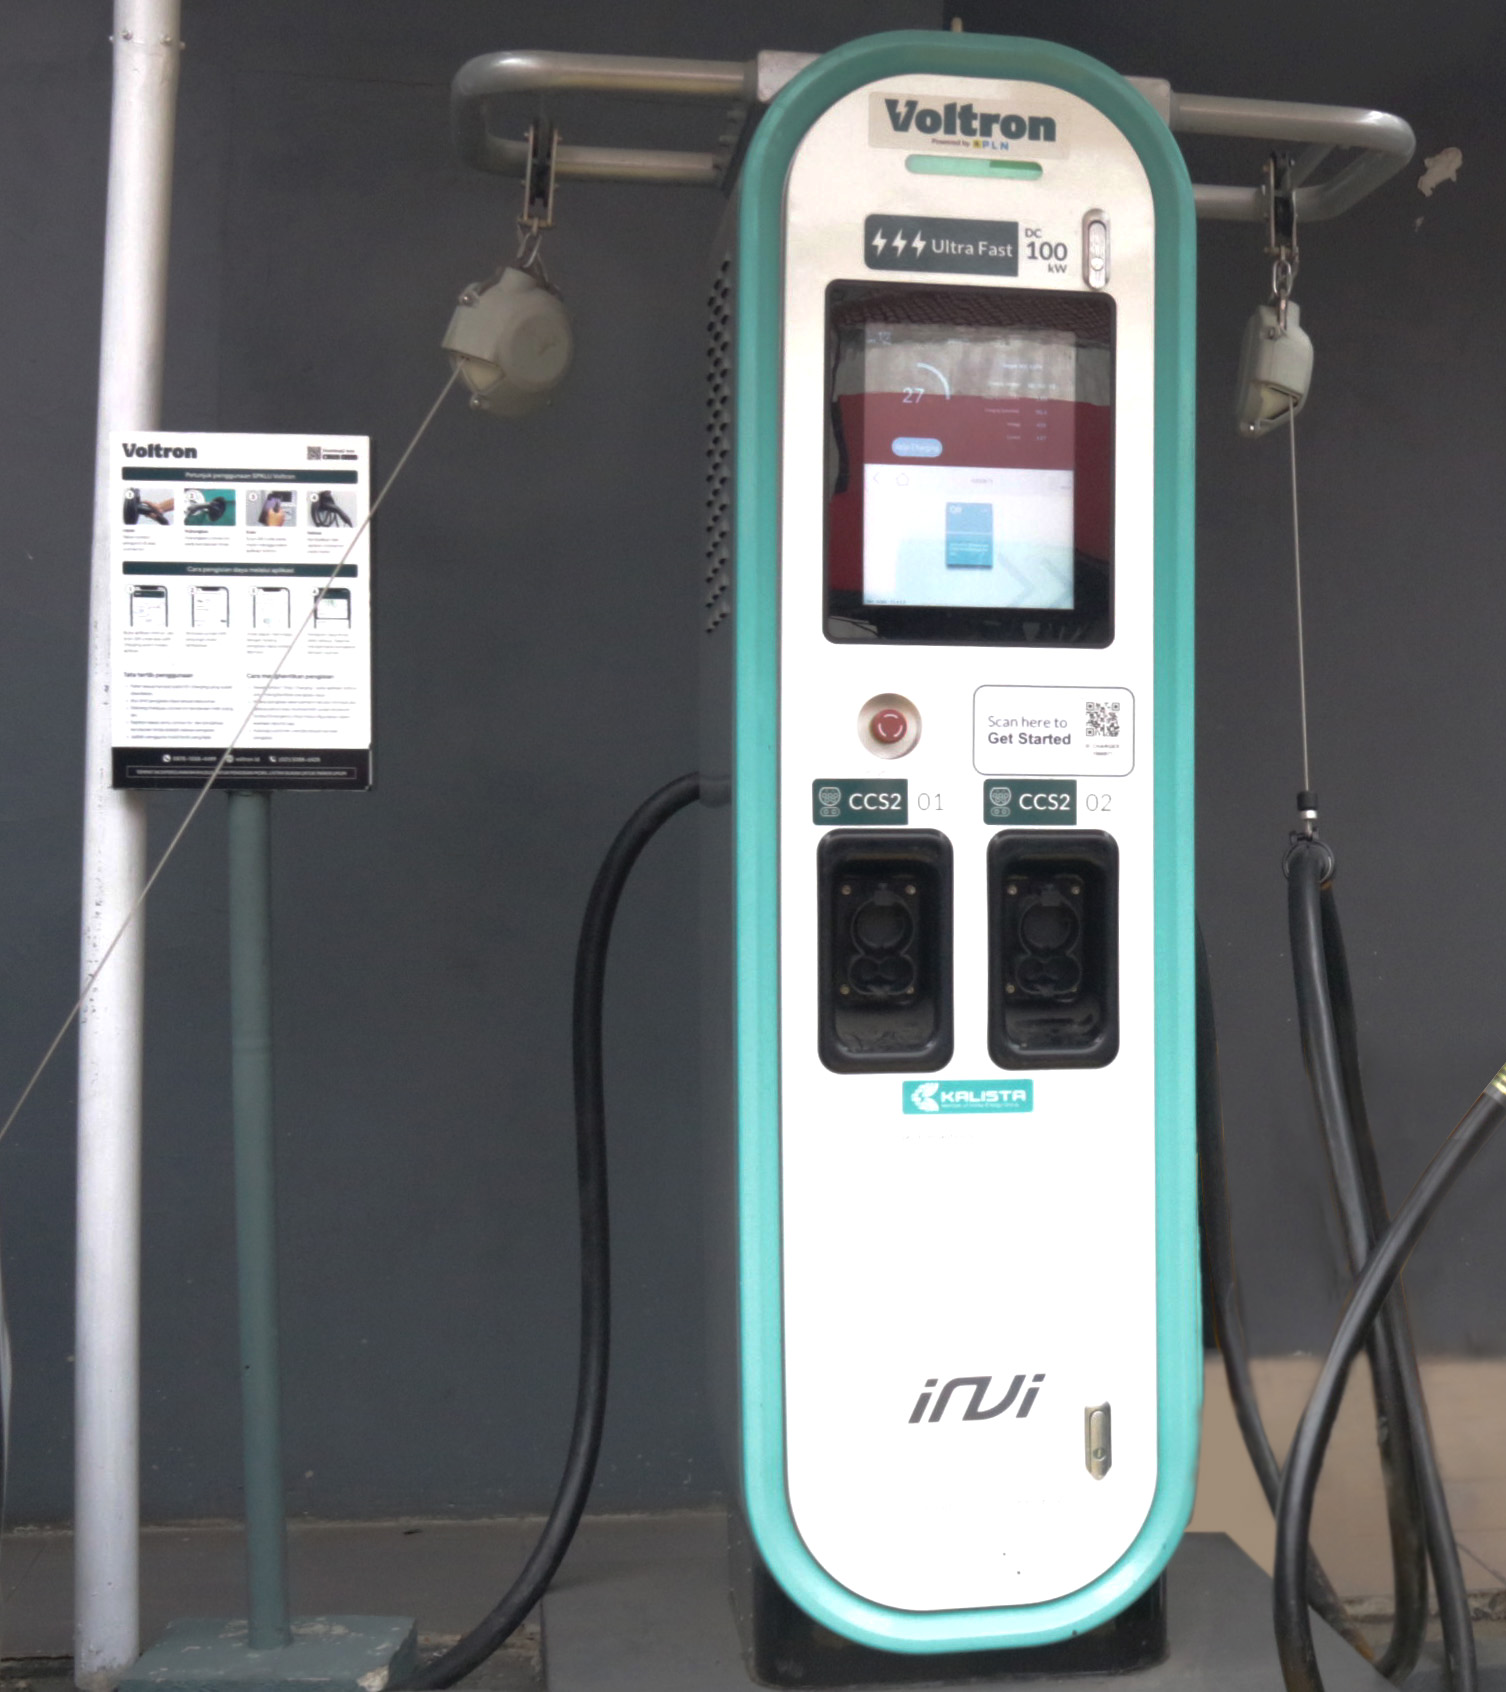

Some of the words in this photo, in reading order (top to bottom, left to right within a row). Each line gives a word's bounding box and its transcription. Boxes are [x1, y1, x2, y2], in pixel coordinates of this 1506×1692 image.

[885, 98, 1057, 142] Voltron
[1025, 228, 1042, 239] DC
[931, 238, 974, 255] Ultra
[978, 240, 1013, 257] Fast
[1026, 241, 1068, 262] 100
[1048, 263, 1068, 274] kW
[902, 387, 925, 404] 27
[122, 443, 198, 459] Voltron
[988, 716, 1018, 728] Scan
[1021, 716, 1051, 728] here
[1054, 717, 1068, 728] to
[988, 733, 1014, 745] Get
[1018, 732, 1071, 746] Started
[849, 793, 902, 811] CCS2
[917, 793, 944, 811] 01
[1019, 794, 1071, 811] CCS2
[1086, 794, 1112, 812] 02
[941, 1090, 1026, 1103] KALISTA
